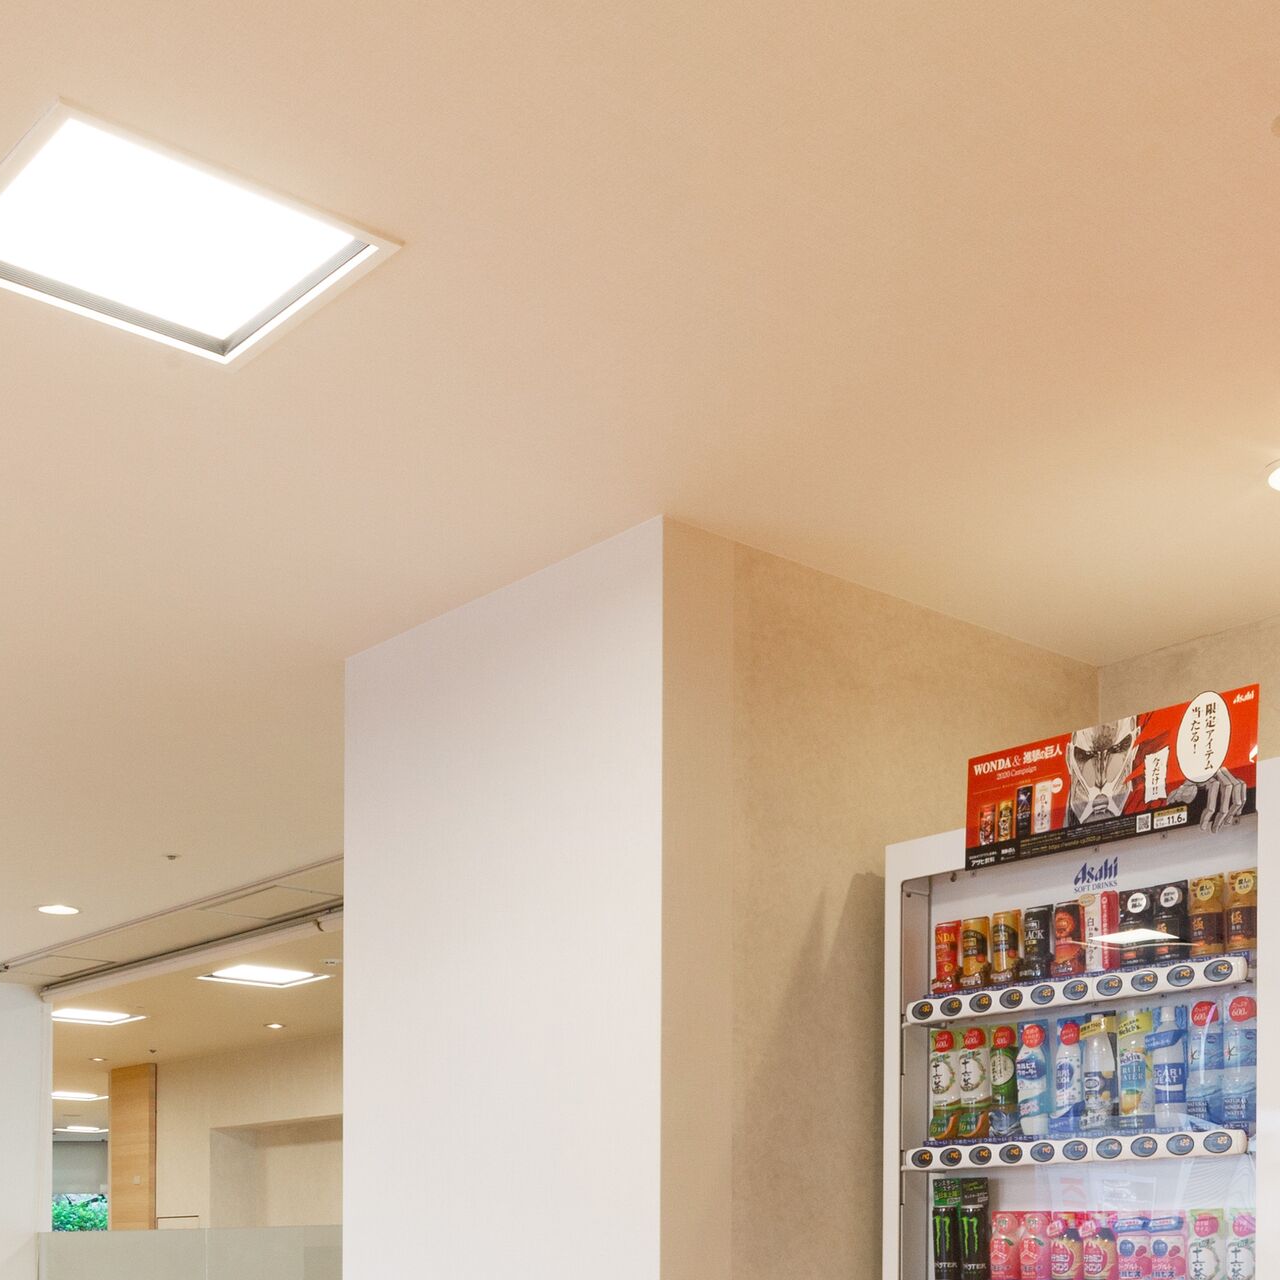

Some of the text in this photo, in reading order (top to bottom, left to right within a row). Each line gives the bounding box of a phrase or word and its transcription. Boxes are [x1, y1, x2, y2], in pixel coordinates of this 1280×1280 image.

[1233, 690, 1255, 704] Asahi
[1205, 702, 1217, 770] 限定アイテム
[973, 759, 1011, 776] WONDA
[1073, 856, 1119, 887] Asahi
[1074, 880, 1118, 893] SOFT DRINKS
[937, 932, 955, 942] NDA
[1024, 930, 1044, 940] LACK
